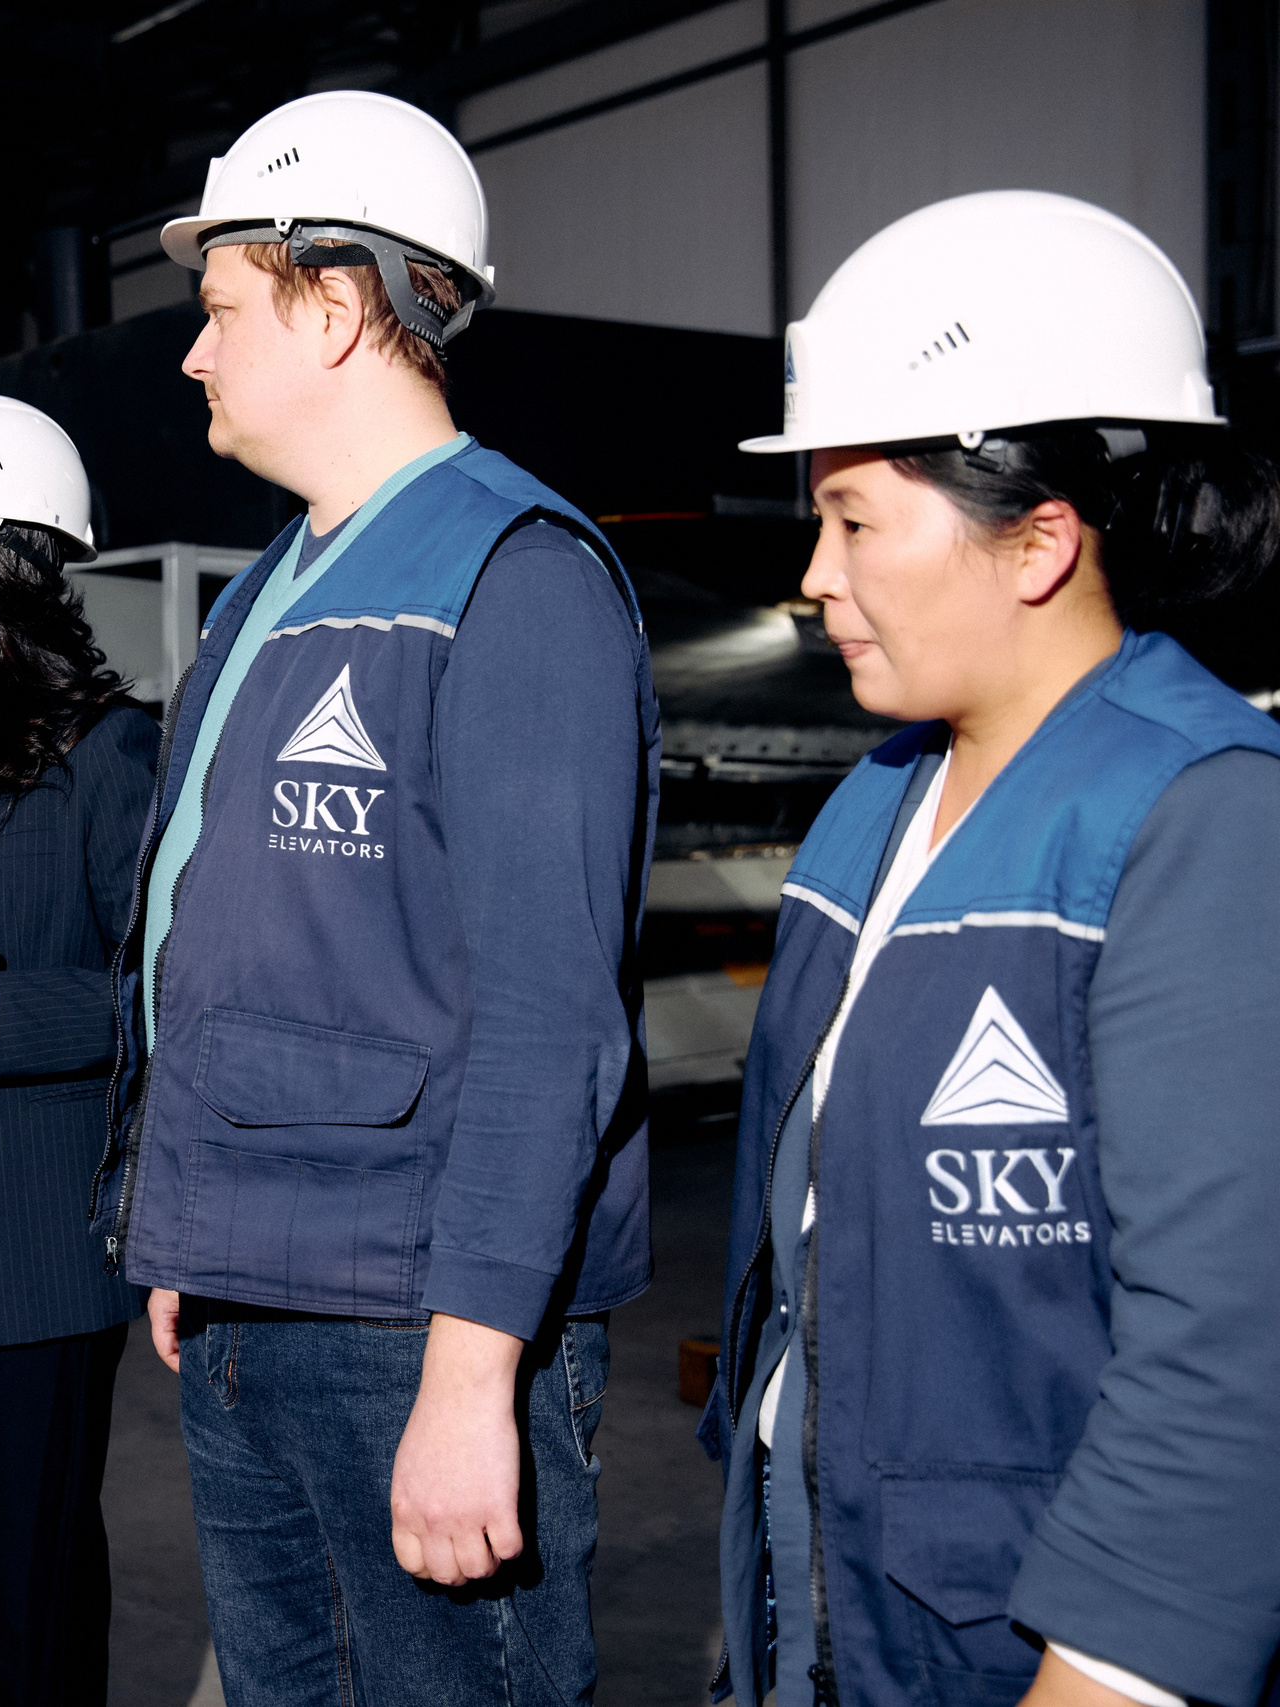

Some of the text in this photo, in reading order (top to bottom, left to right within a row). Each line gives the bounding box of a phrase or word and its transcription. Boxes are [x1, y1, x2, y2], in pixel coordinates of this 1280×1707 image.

[272, 780, 385, 835] SKY
[268, 834, 385, 859] ELEVATORS
[925, 1147, 1077, 1216] SKY
[931, 1221, 1092, 1247] ELEVATORS
